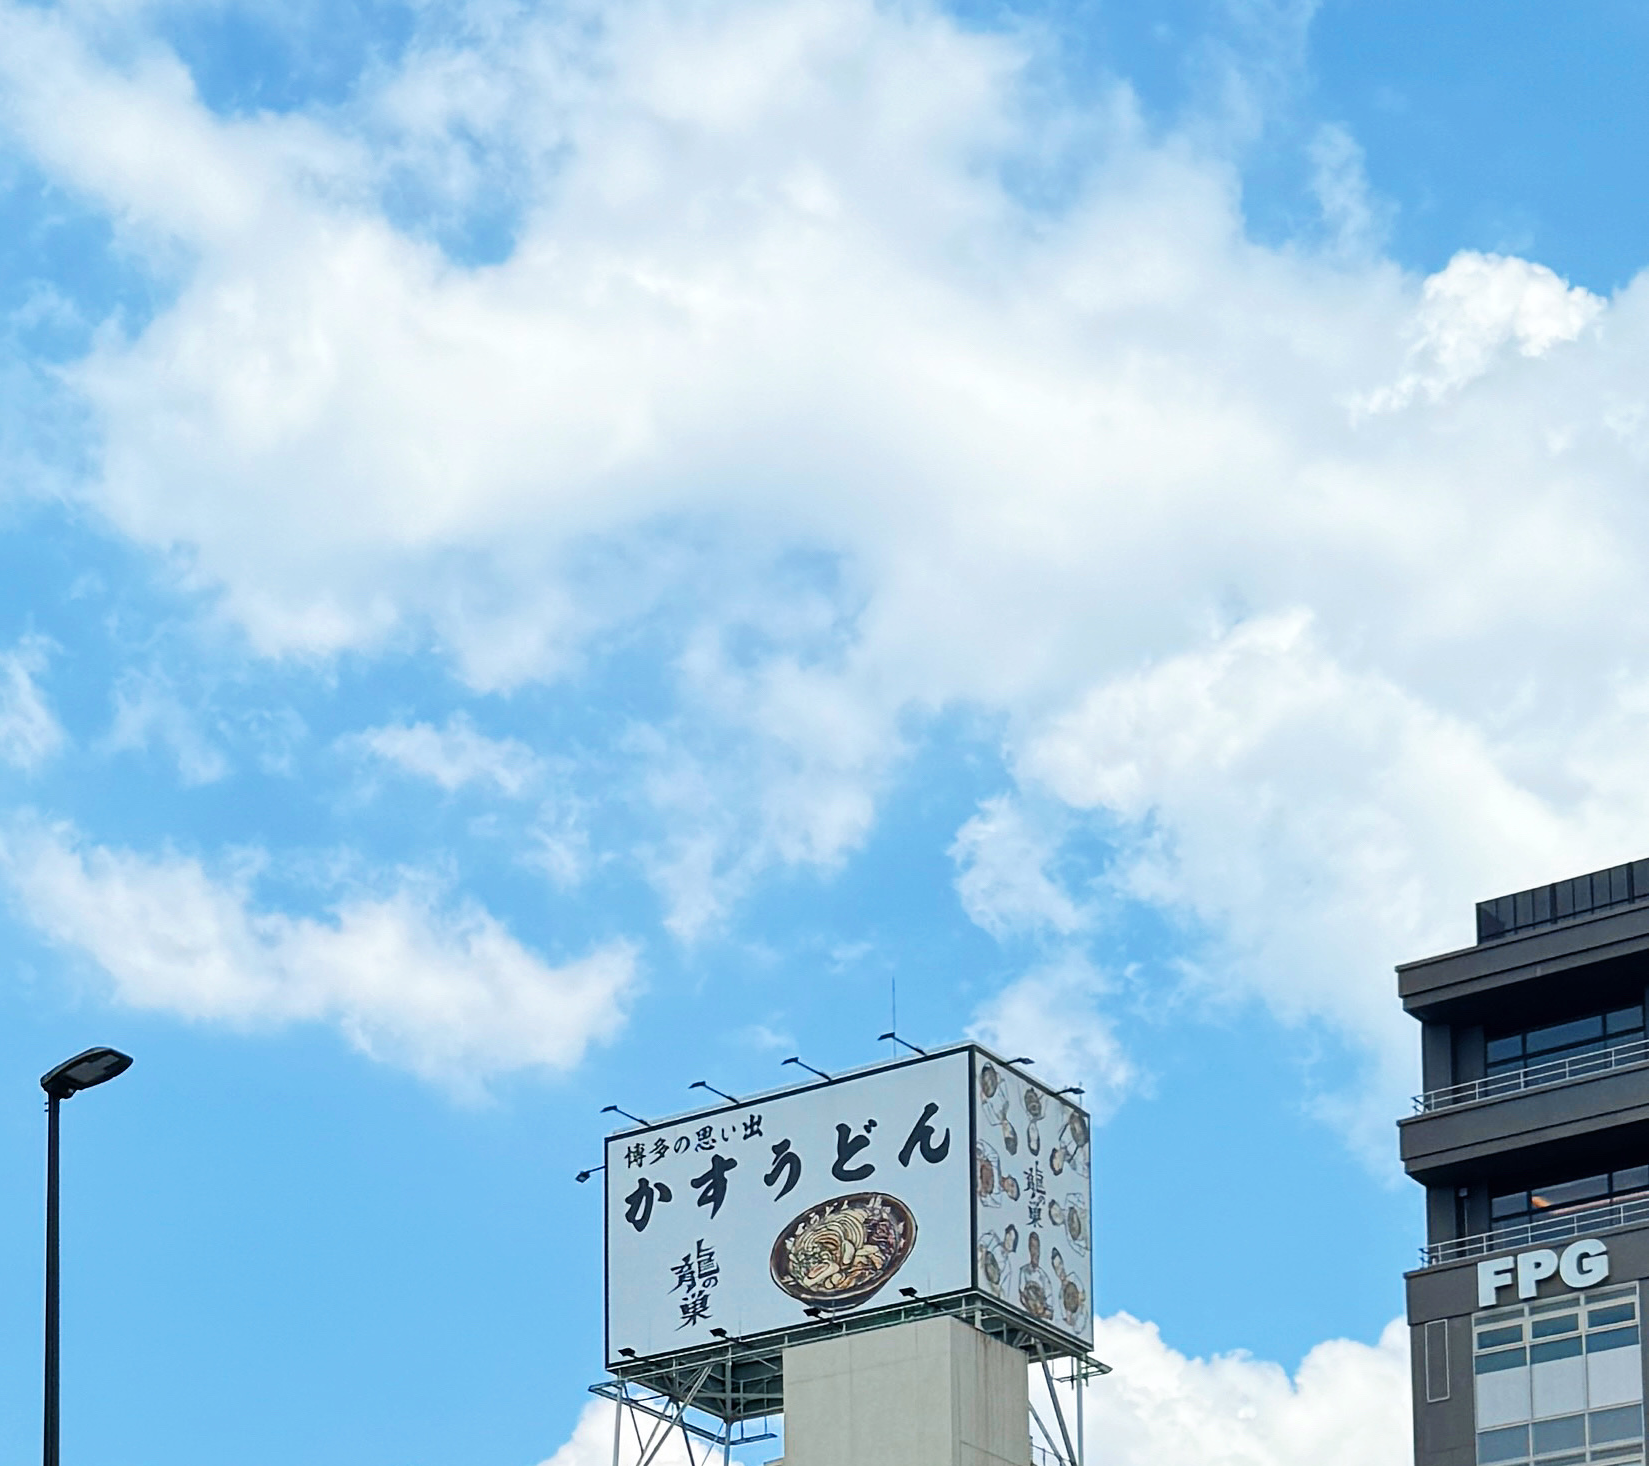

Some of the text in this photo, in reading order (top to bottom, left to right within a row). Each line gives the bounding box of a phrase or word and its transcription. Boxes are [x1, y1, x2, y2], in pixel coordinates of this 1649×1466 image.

[624, 1114, 763, 1169] 博多の思い出
[624, 1102, 951, 1232] かすうどん
[667, 1238, 720, 1331] 龍の巣
[1477, 1238, 1609, 1308] FPG
